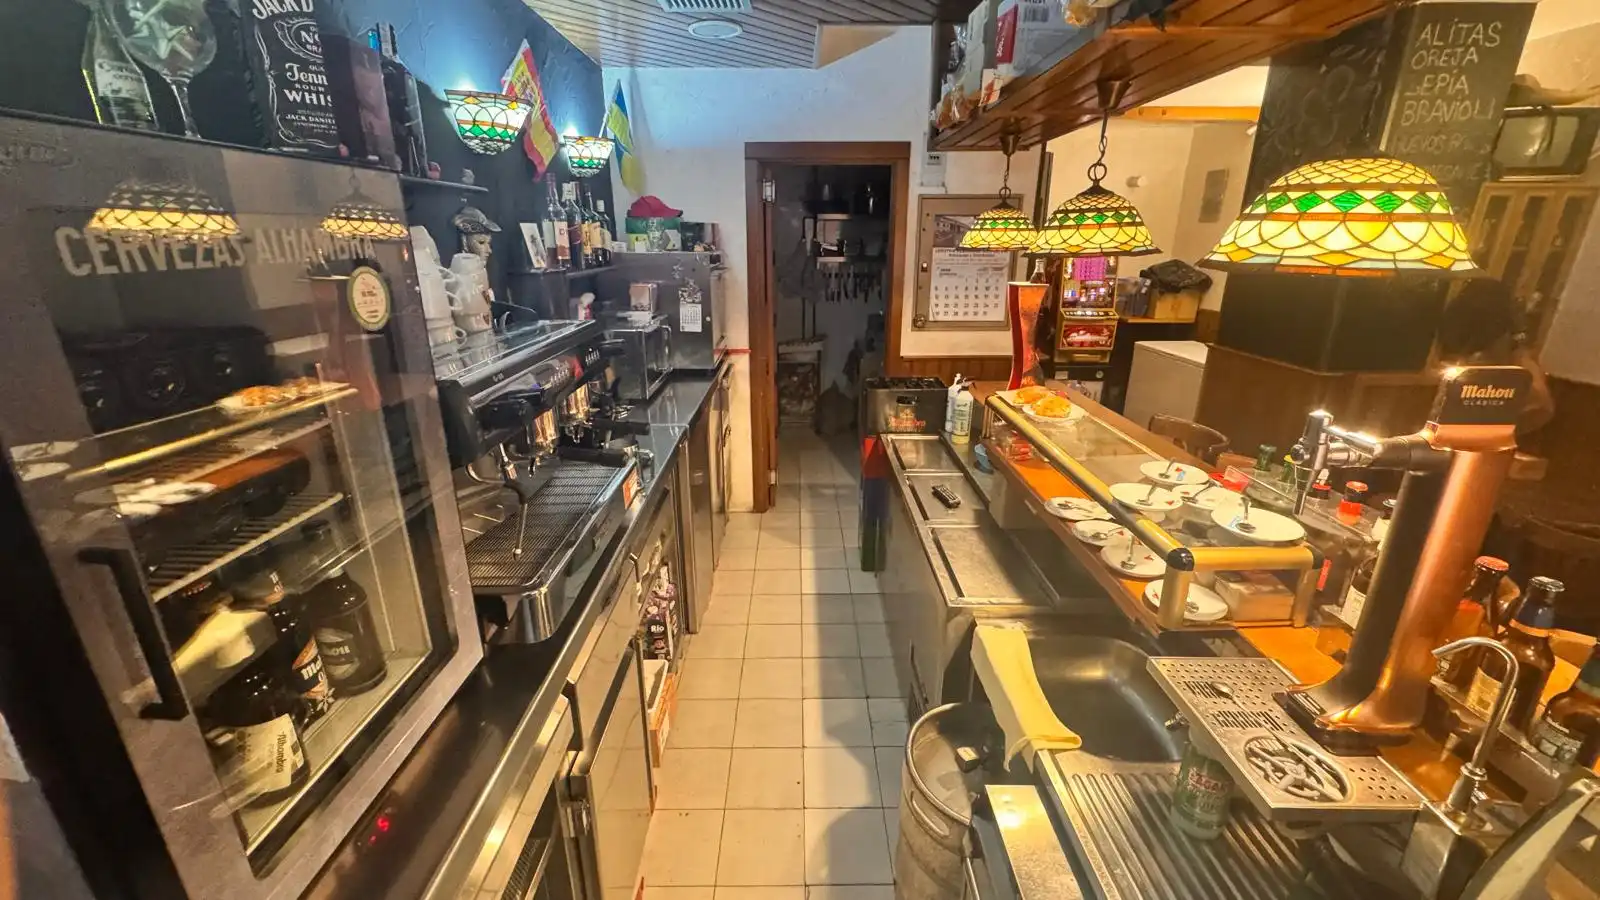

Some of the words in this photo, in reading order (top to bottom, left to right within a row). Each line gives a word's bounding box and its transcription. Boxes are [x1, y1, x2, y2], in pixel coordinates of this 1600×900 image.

[1410, 46, 1479, 70] OREJA
[54, 226, 247, 277] CERVEZAS
[1461, 385, 1516, 398] Mahou
